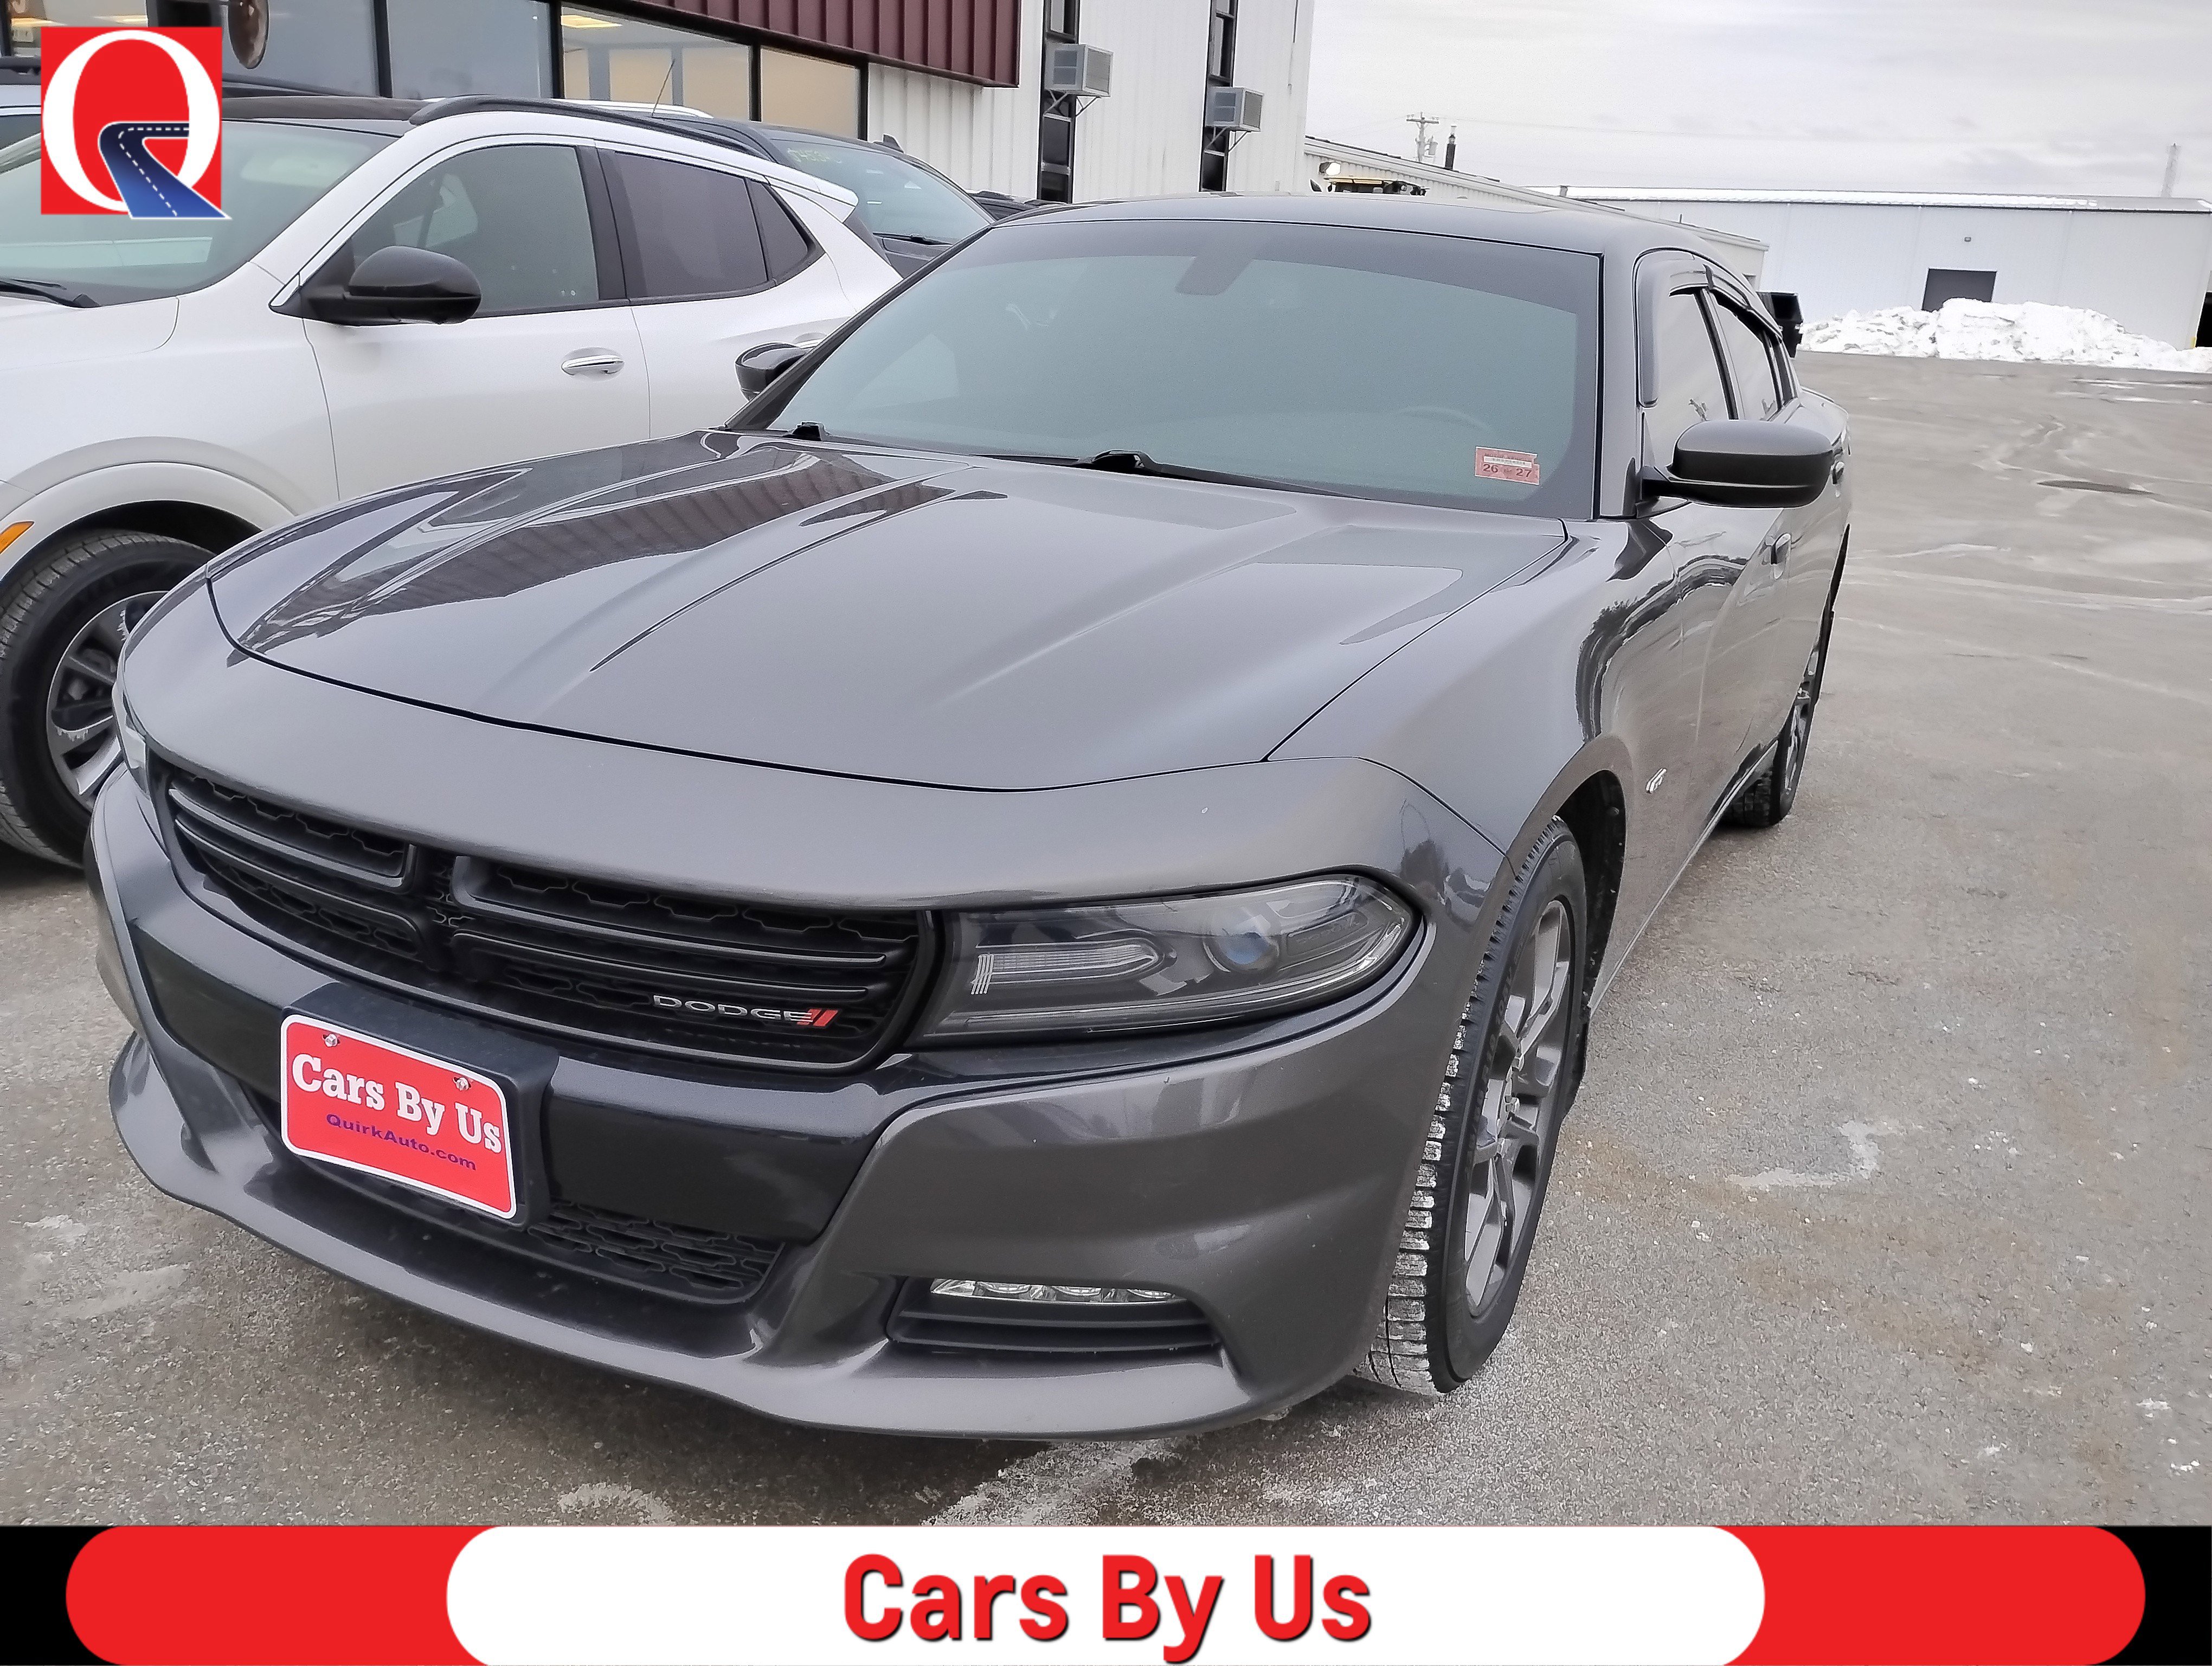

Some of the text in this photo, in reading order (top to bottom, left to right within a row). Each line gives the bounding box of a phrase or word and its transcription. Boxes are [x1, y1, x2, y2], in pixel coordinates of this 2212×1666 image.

[1483, 464, 1532, 477] 26 27
[653, 995, 813, 1023] DODGE
[292, 1053, 502, 1154] Cars By Us
[326, 1113, 477, 1171] QuirkAuto.com
